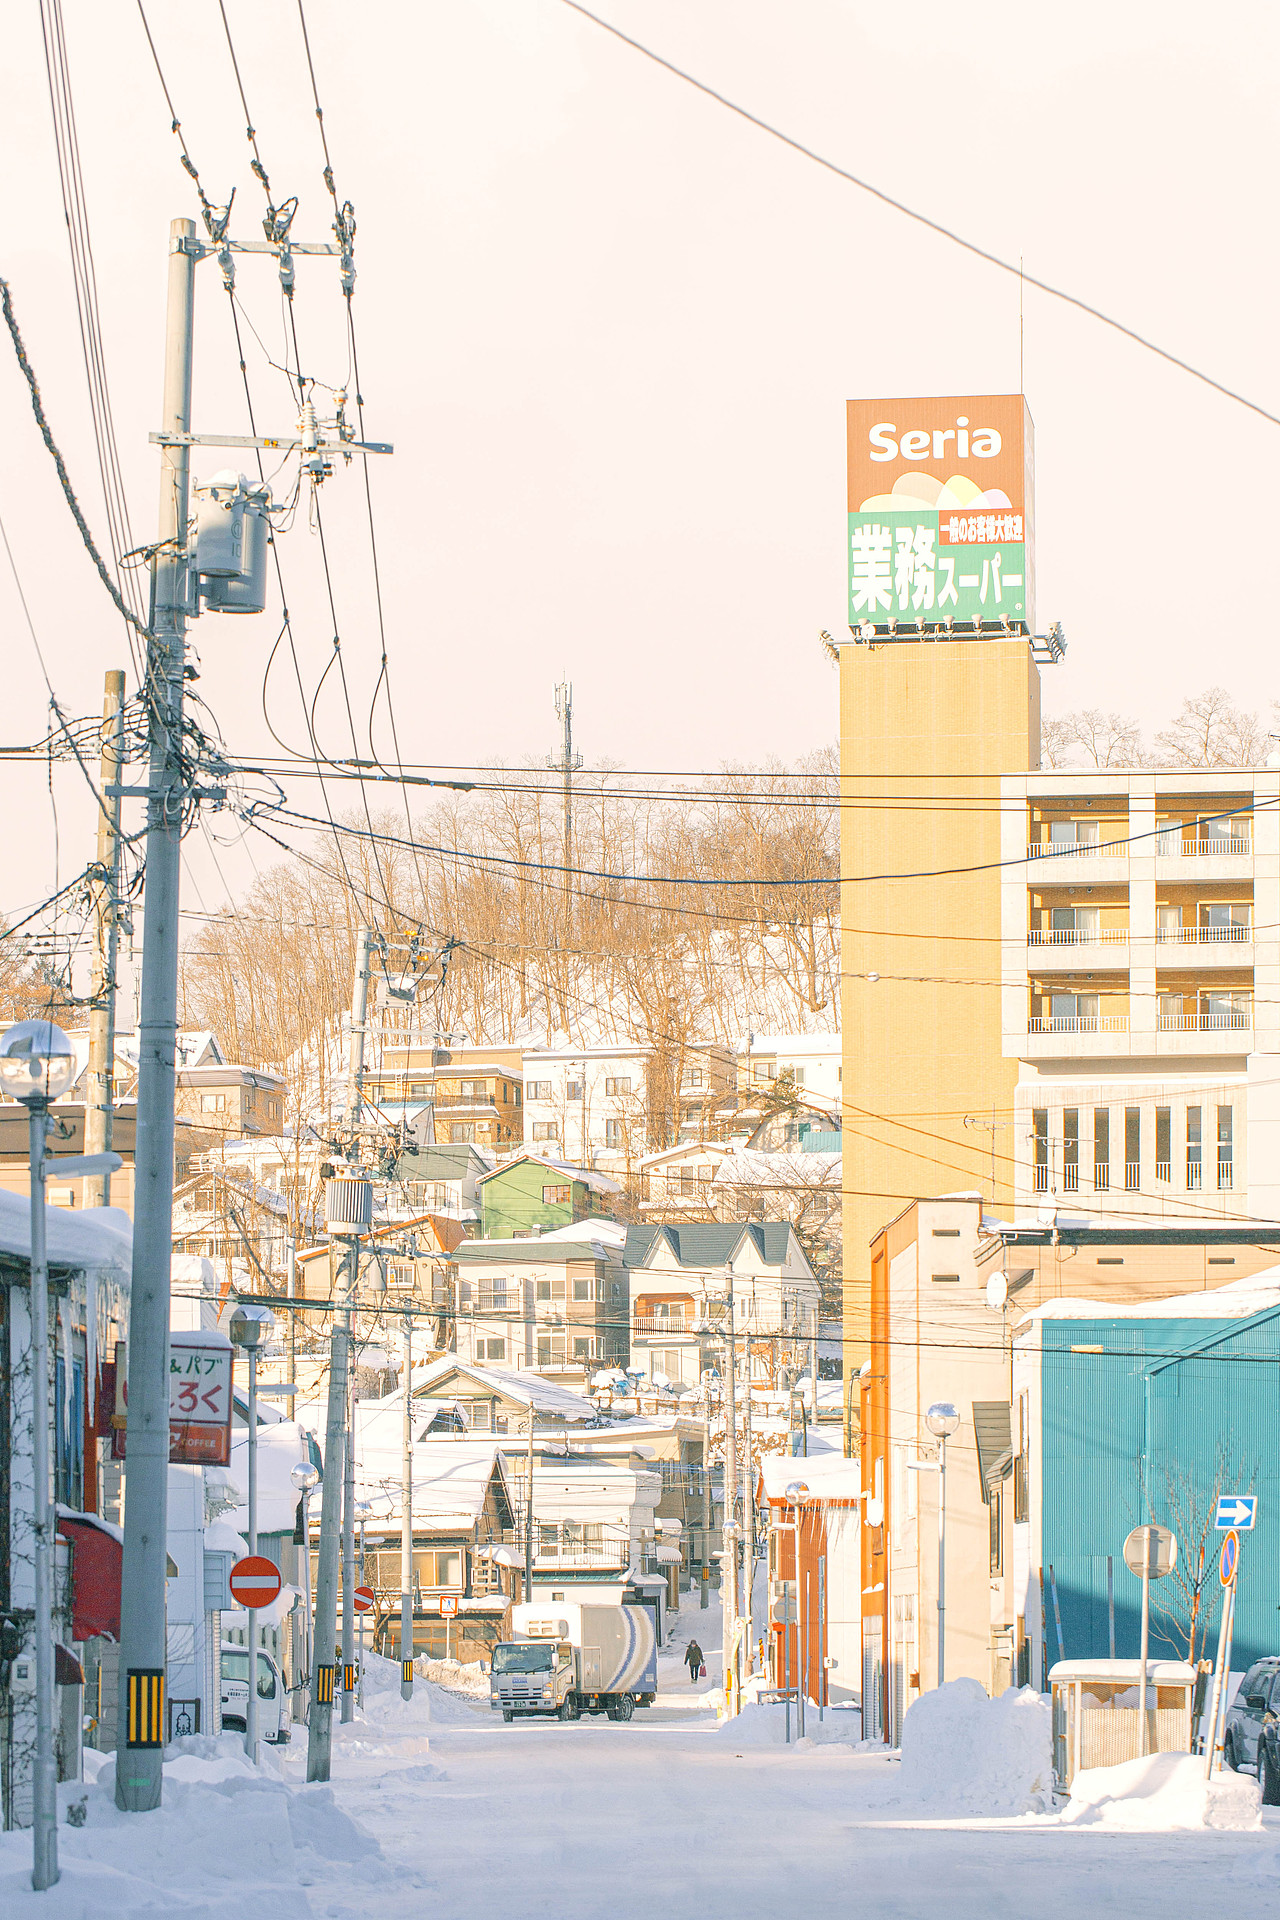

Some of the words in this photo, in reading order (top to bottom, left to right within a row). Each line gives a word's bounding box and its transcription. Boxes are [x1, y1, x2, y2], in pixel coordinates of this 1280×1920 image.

[868, 415, 1002, 462] Seria
[851, 523, 1023, 612] 業務スーパー
